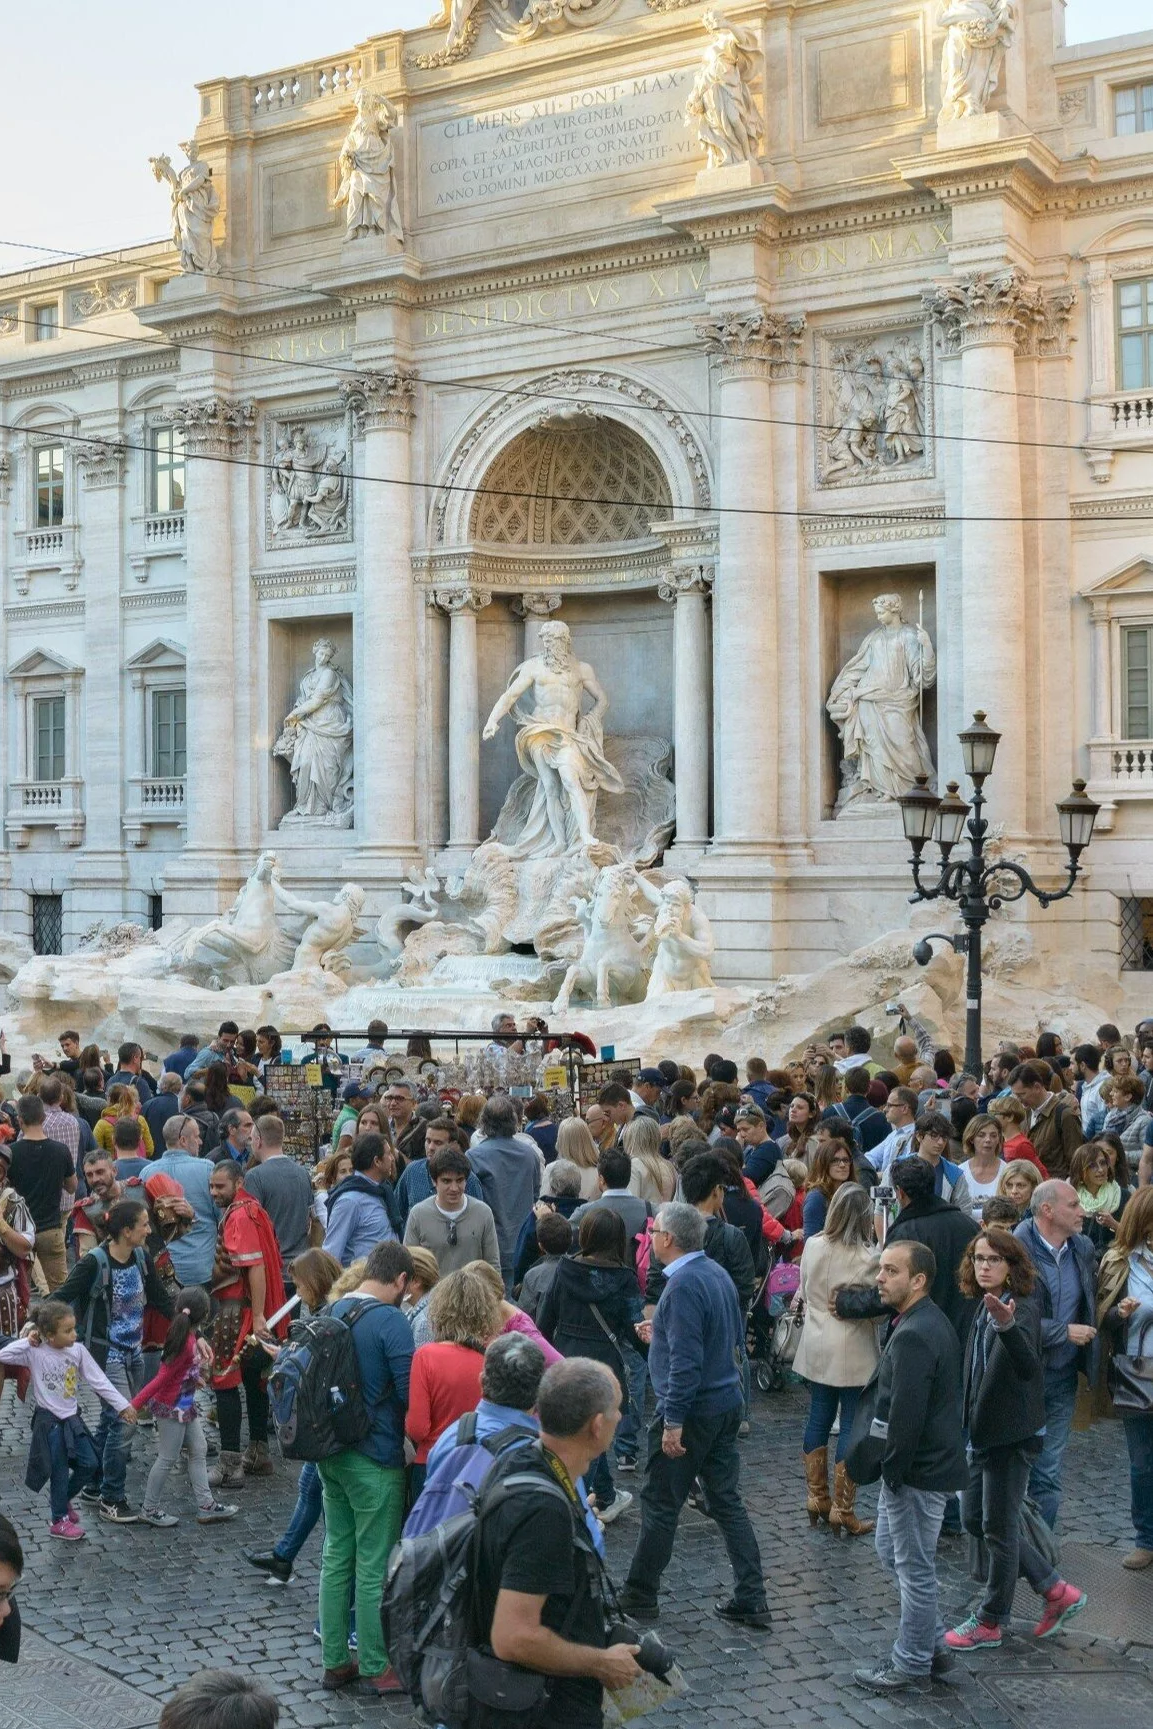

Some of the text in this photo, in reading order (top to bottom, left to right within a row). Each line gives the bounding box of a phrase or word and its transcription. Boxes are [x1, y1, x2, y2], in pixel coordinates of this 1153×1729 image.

[444, 109, 521, 138] CLEMENS
[496, 105, 623, 143] AQVAM VIRGINEM
[430, 157, 467, 174] COPIA
[473, 151, 488, 165] ET
[492, 132, 577, 160] SALVBRITATE
[462, 130, 661, 182] CVLTV MAGNIFICO ORNAVIT
[435, 187, 473, 205] ANNO
[478, 175, 527, 195] DOMINI
[425, 280, 621, 336] BENEDICTVS
[648, 264, 708, 298] XIV
